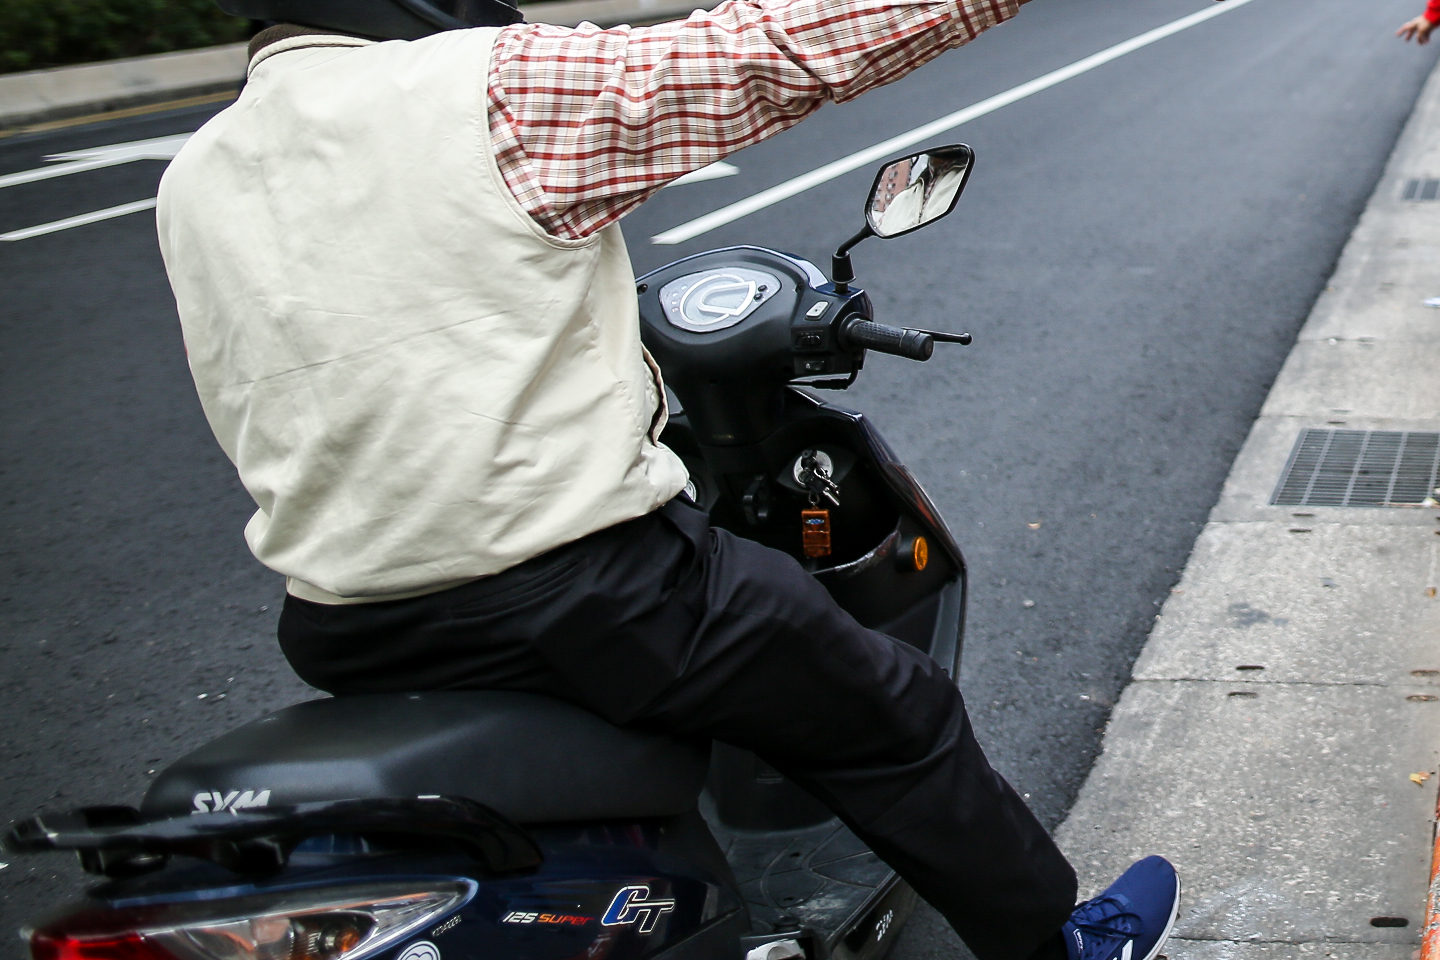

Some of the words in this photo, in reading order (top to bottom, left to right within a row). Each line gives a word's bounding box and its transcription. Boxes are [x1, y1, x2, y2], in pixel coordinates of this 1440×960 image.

[190, 790, 271, 816] SYM
[502, 911, 539, 924] 125
[601, 884, 675, 933] GT
